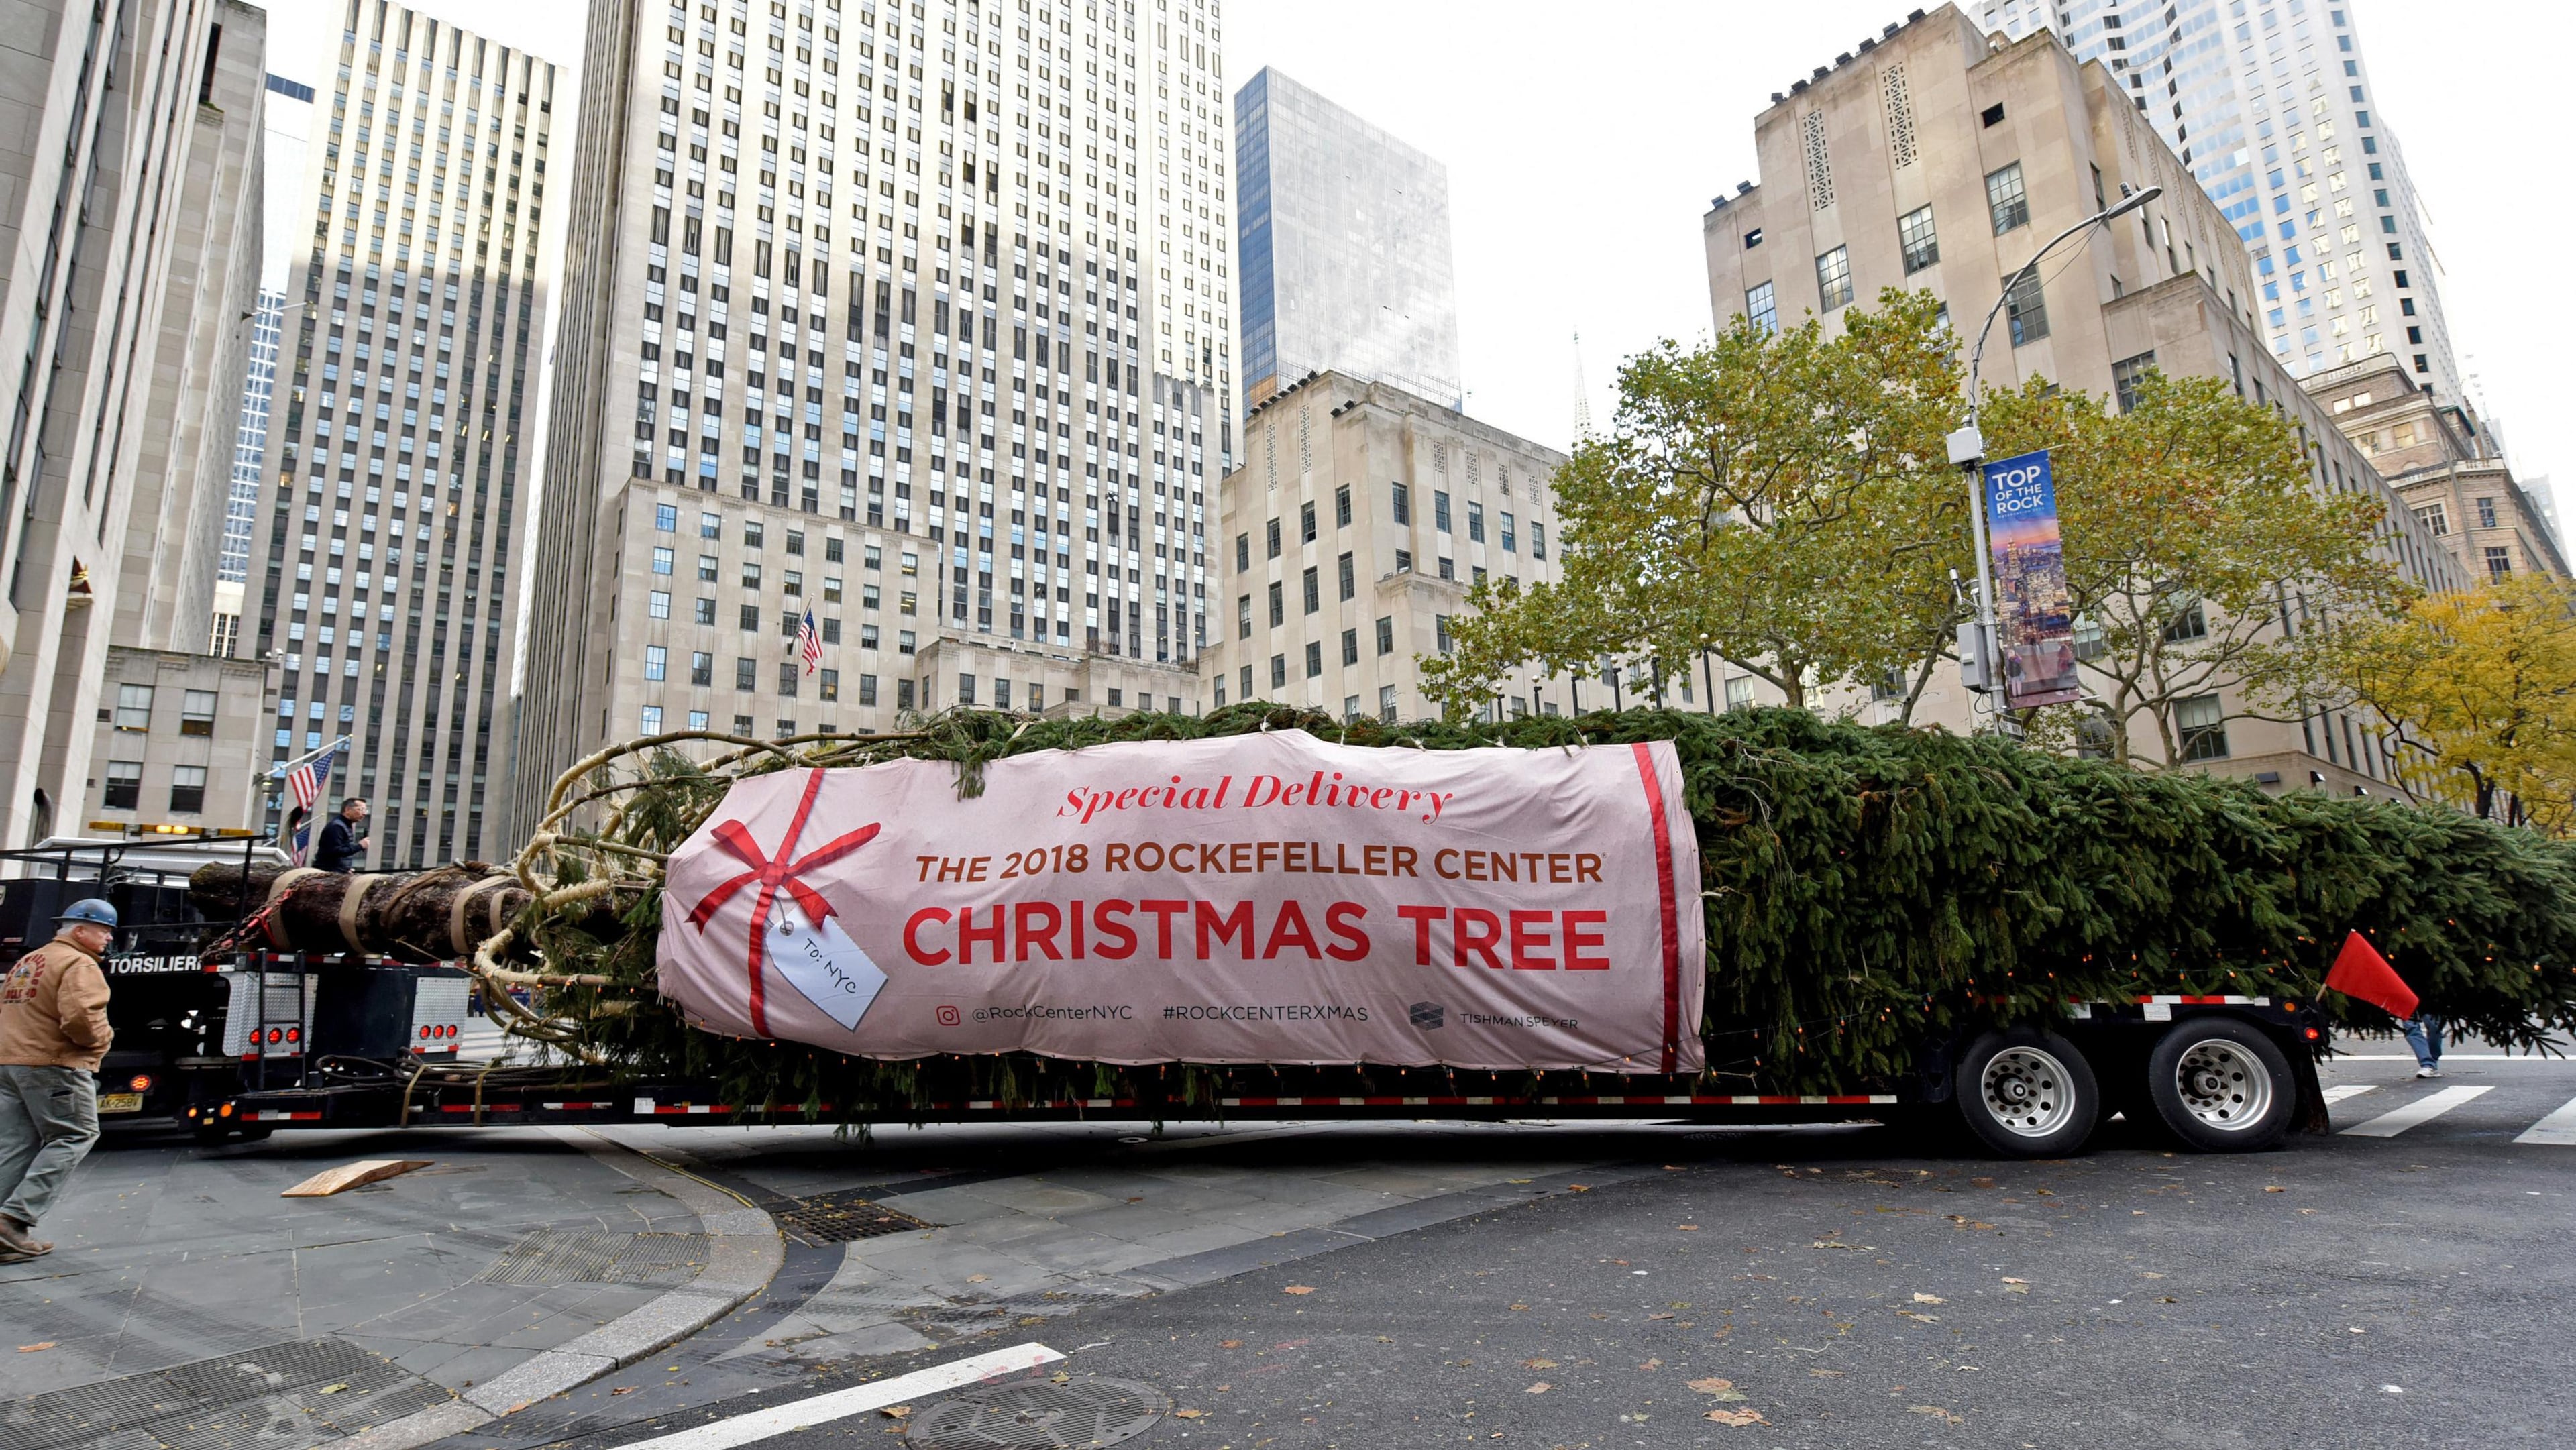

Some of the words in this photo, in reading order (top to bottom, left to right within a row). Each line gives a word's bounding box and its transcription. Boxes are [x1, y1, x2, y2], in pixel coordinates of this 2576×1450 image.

[1992, 465, 2041, 490] TOP
[1995, 490, 2013, 502] OF
[2015, 483, 2043, 497] THE
[1996, 494, 2044, 514] ROCK
[1057, 775, 1232, 824] Special
[1238, 771, 1453, 824] Delivery
[916, 856, 991, 883] THE
[1000, 845, 1089, 879] 2018
[1105, 842, 1419, 877] ROCKEFELLER
[903, 899, 1371, 966] CHRISTMAS
[1397, 905, 1610, 970] TREE
[824, 960, 856, 993] NYC
[972, 1004, 1132, 1023] @RockCenterNYC
[1163, 1005, 1368, 1021] #ROCKCENTERXMAS
[1460, 1013, 1523, 1027] TISHMAN
[1526, 1016, 1578, 1029] SPEYER
